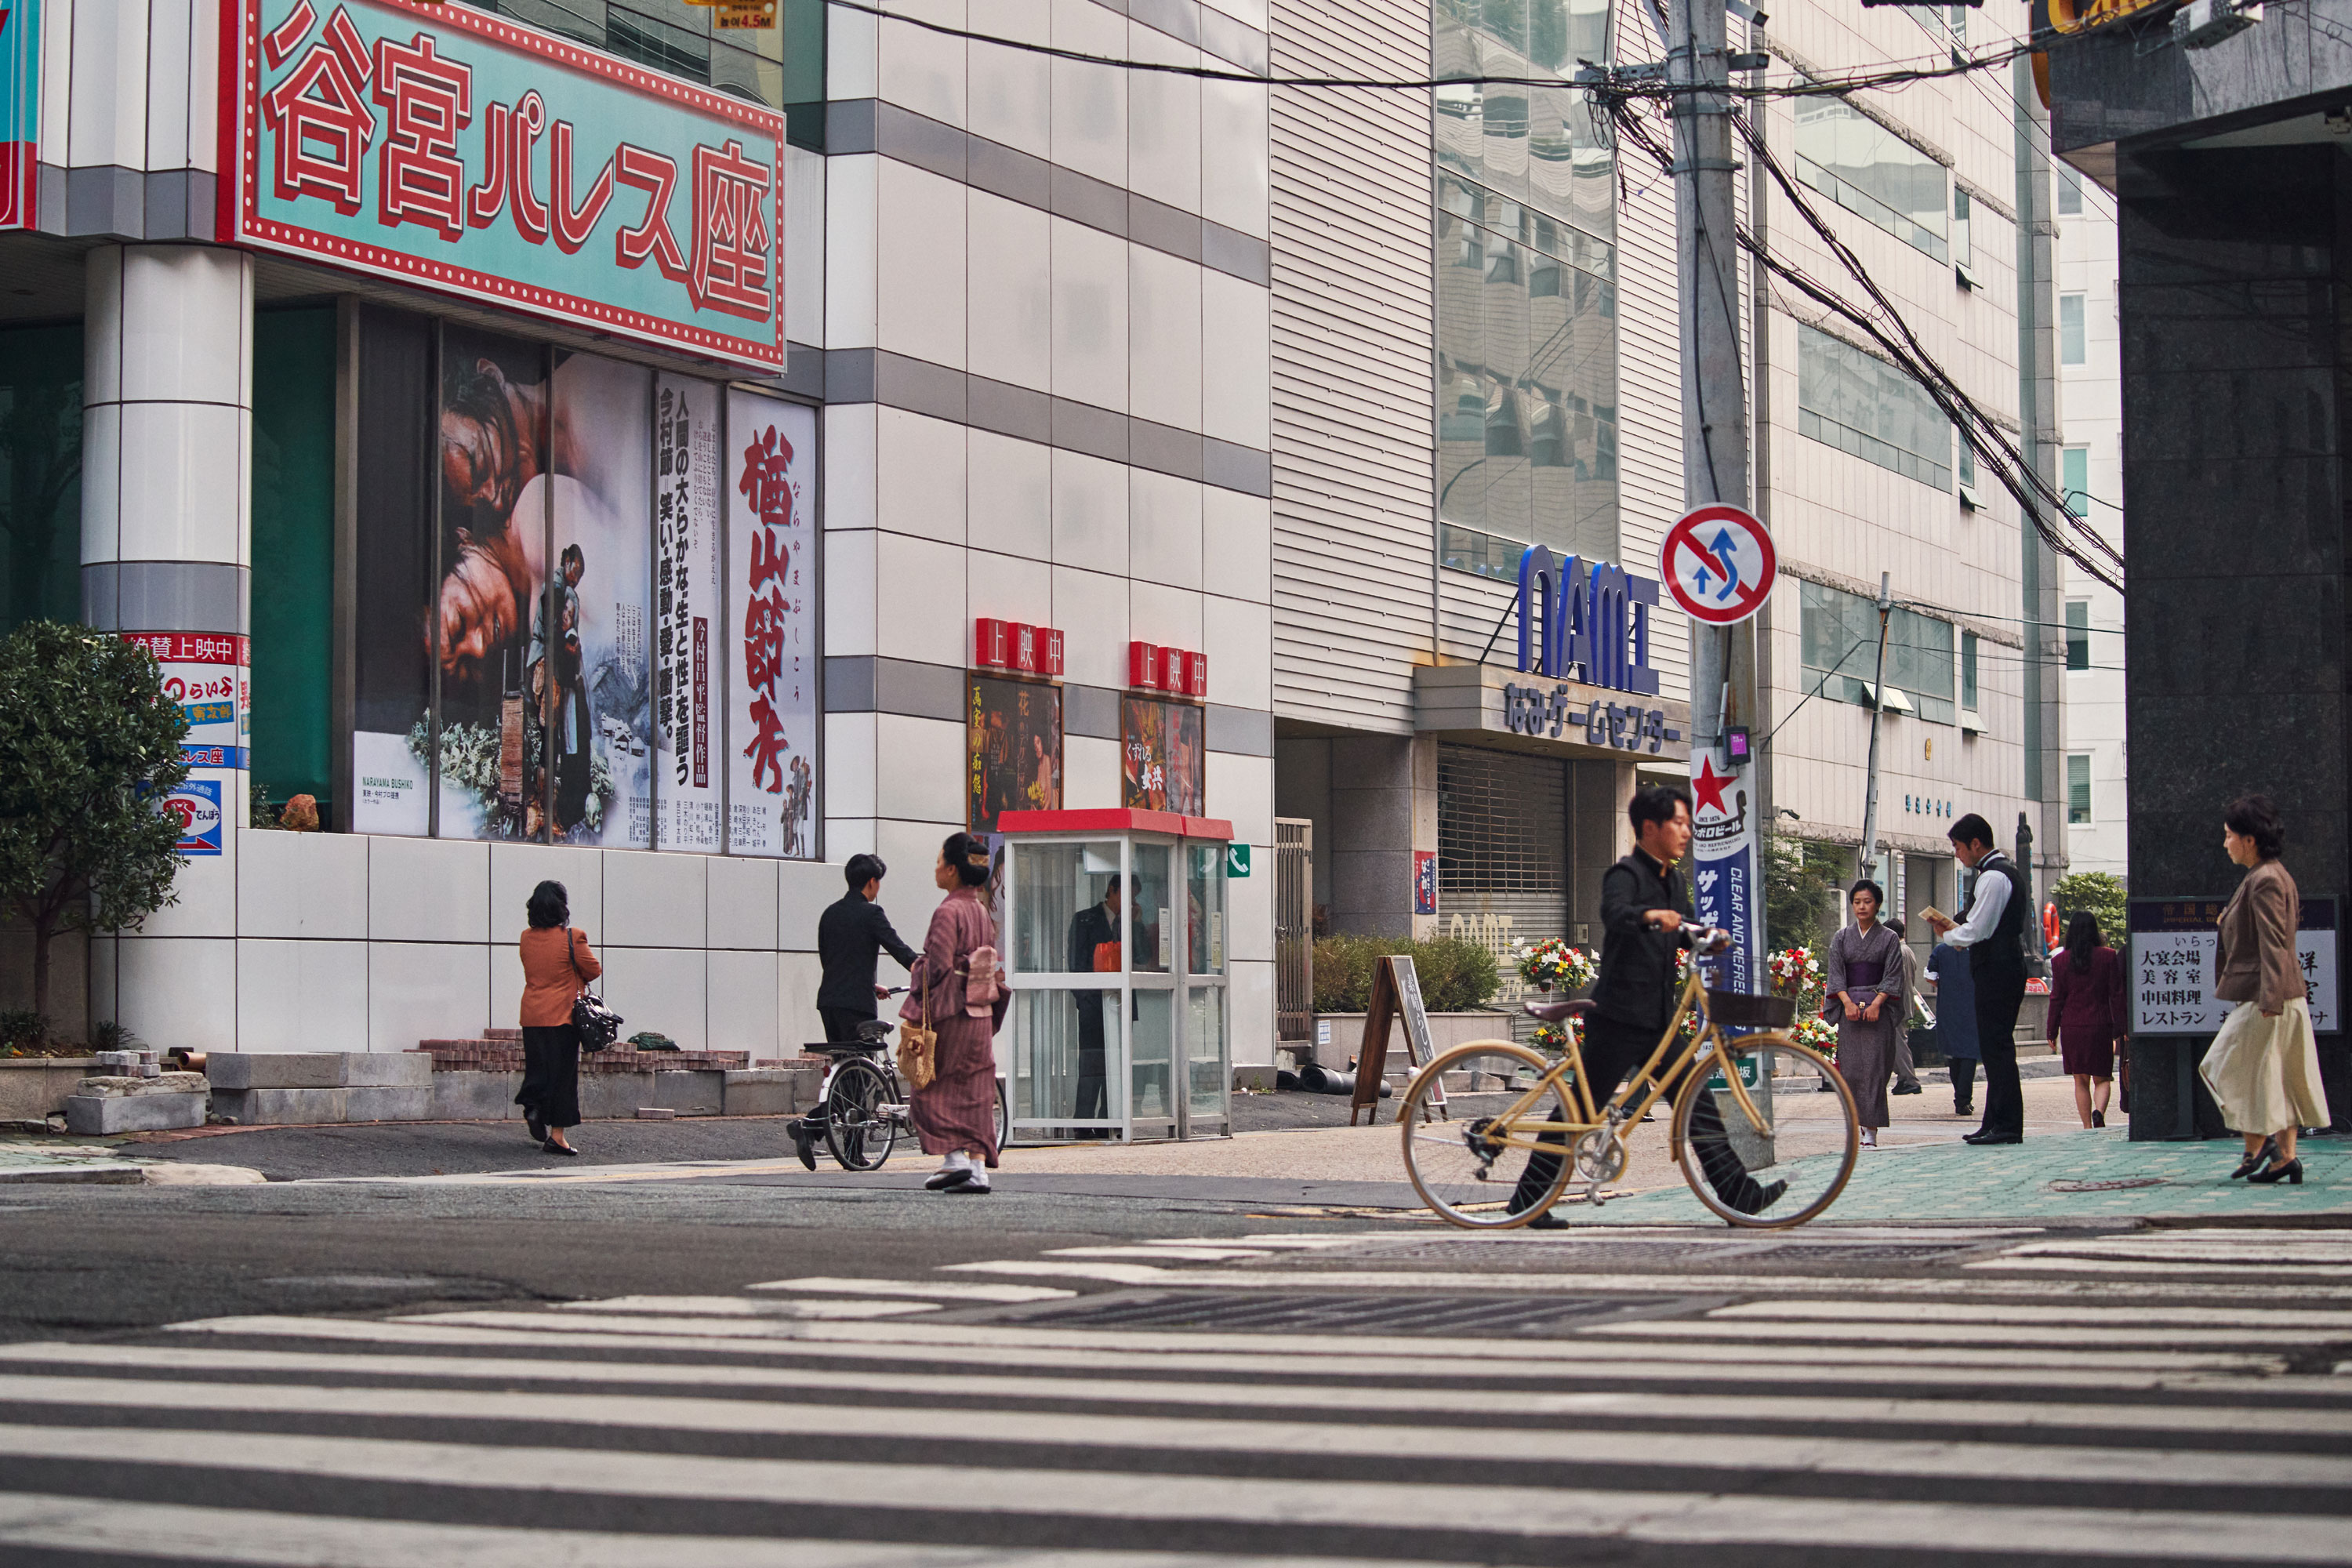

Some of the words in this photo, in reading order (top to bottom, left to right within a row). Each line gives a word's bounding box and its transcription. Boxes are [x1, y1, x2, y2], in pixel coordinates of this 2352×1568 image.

[742, 15, 771, 27] 4.5M
[261, 0, 771, 323] 谷宮パレス座
[739, 423, 793, 795] 楢山節考
[793, 481, 801, 702] ならやまぶしこう
[1518, 544, 1660, 696] NAMI
[990, 622, 1061, 673] 上映中
[1143, 645, 1205, 694] 上映中
[695, 621, 706, 784] 今村昌平監督作品
[1505, 681, 1681, 753] なみゲームセンター
[1127, 742, 1152, 762] くずれる
[362, 776, 390, 788] NARAYAMA
[391, 779, 413, 790] BUSHIKO
[1730, 867, 1744, 912] CLEAR
[1731, 913, 1744, 944] AND
[2140, 949, 2201, 966] 大宴会場
[2141, 968, 2201, 985] 美容室
[2141, 989, 2201, 1006] 中国料理
[2142, 1011, 2208, 1026] レストラン
